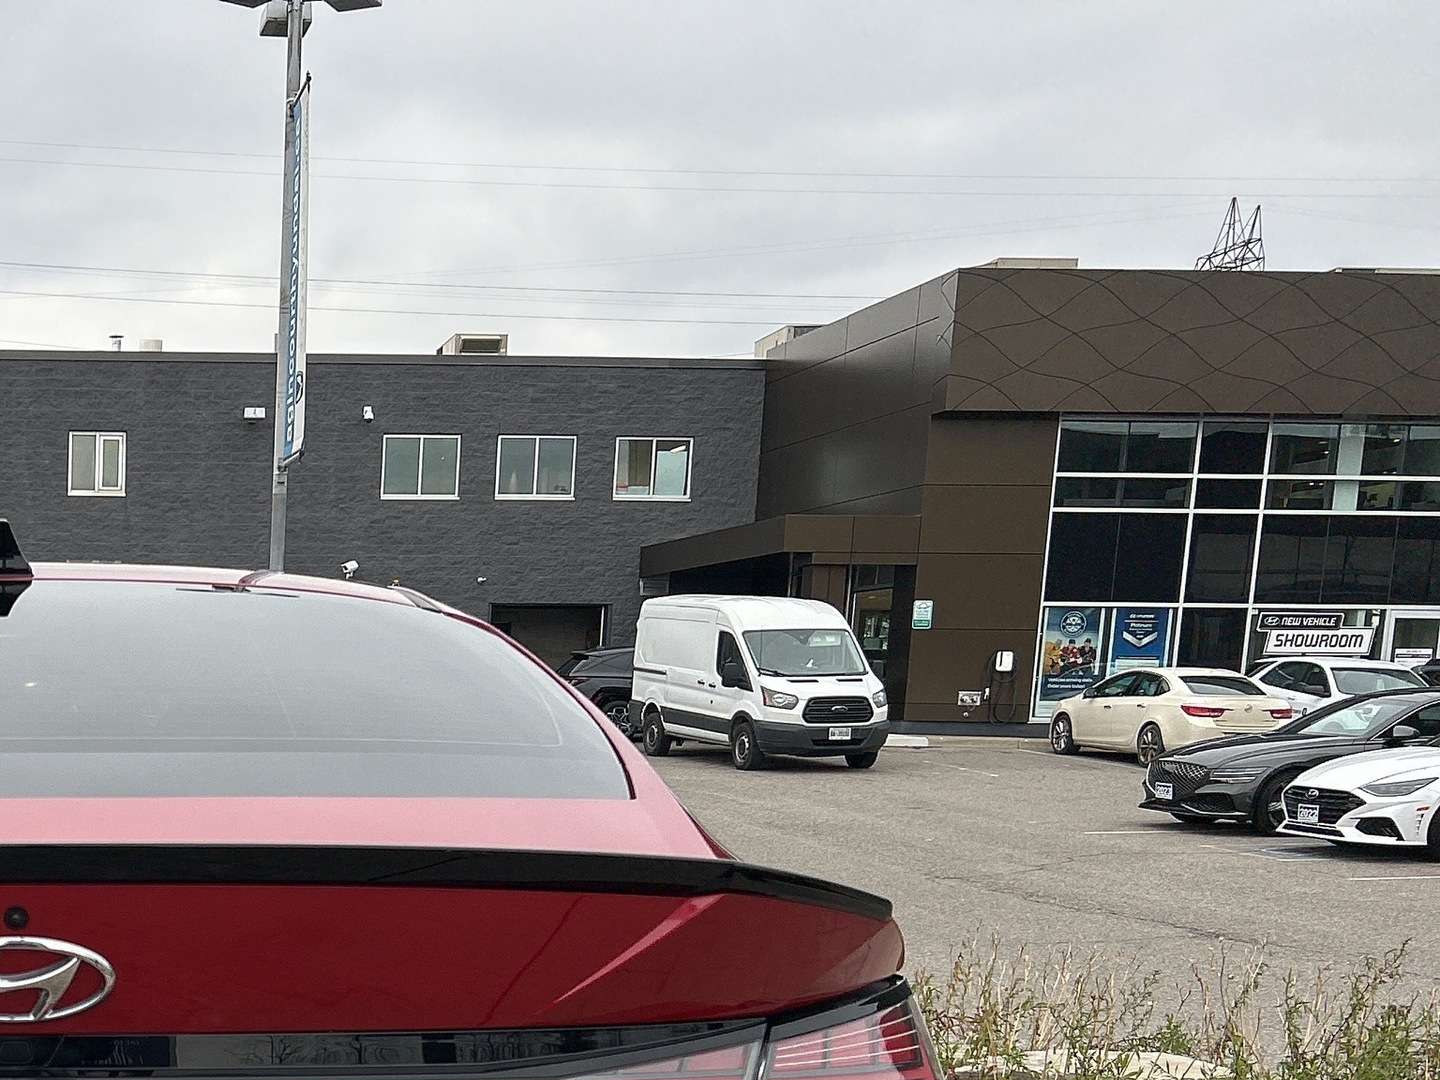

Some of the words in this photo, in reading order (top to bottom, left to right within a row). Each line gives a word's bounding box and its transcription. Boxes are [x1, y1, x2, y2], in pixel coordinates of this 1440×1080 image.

[1281, 616, 1301, 626] NEW
[1303, 617, 1337, 626] VEHICLE
[1273, 633, 1364, 648] SHOWROOM
